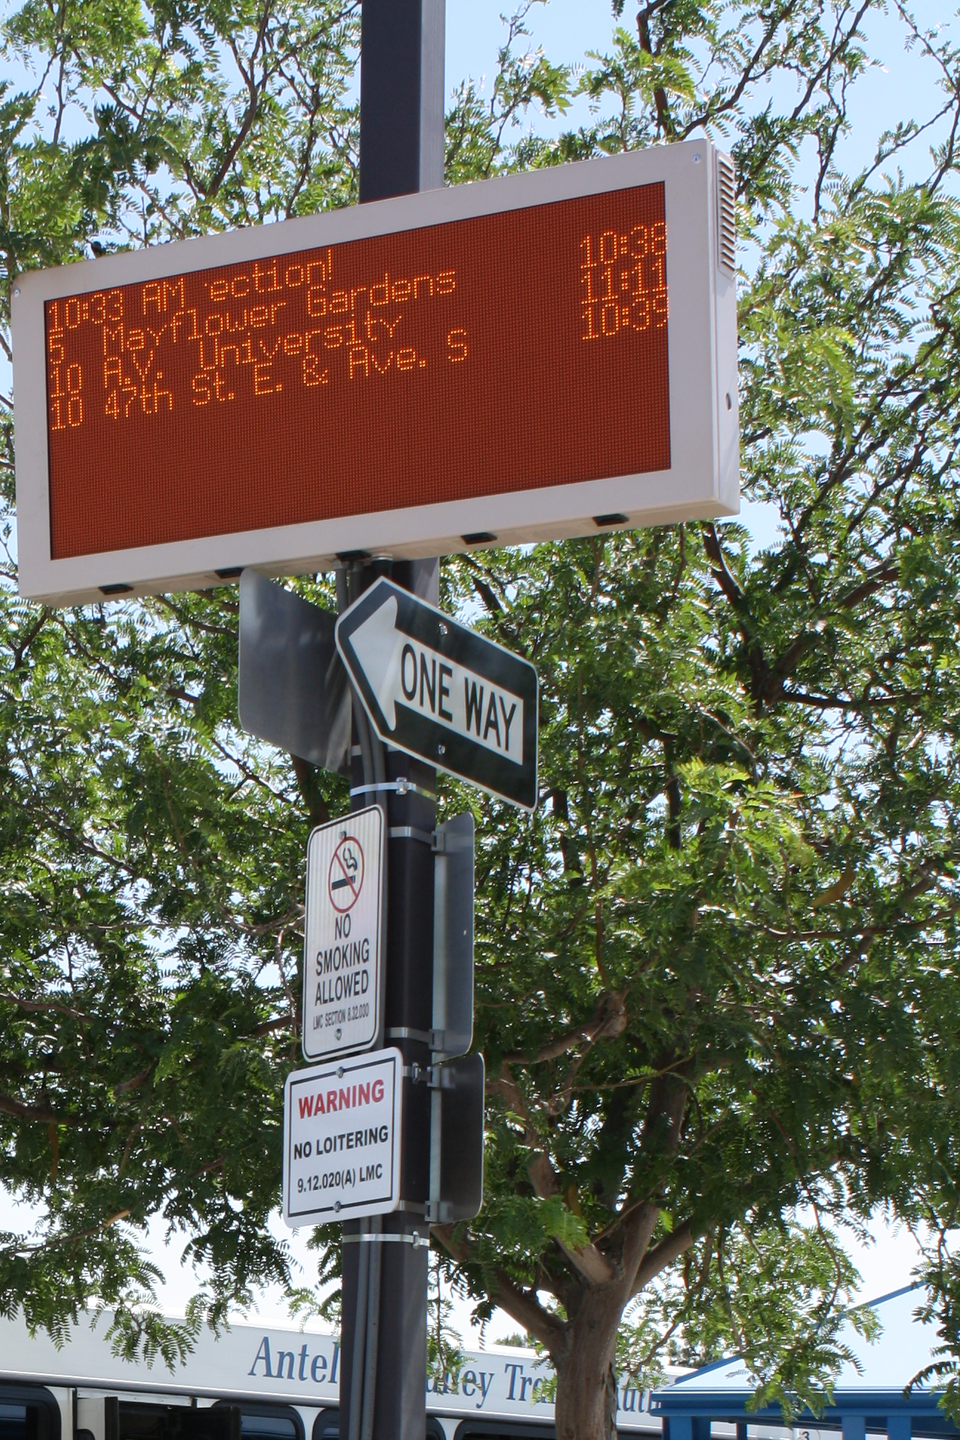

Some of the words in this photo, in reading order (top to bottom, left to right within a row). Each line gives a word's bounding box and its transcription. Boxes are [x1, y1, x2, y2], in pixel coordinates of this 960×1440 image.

[48, 333, 66, 365] 5
[102, 301, 288, 356] Mayflower
[306, 270, 457, 319] Gardens
[579, 221, 668, 269] 10:38
[48, 290, 124, 332] 10:33
[142, 277, 185, 316] AM
[50, 362, 83, 398] 10
[103, 349, 163, 389] A.V.
[198, 311, 403, 370] University
[580, 258, 669, 305] 11:11
[50, 396, 84, 431] 10
[104, 384, 174, 420] 47th
[192, 370, 236, 406] St.
[253, 361, 284, 396] E.
[301, 353, 330, 387] &
[348, 345, 427, 379] Ave.
[447, 328, 469, 363] S
[581, 293, 671, 341] 10:39
[400, 642, 453, 724] ONE
[464, 676, 518, 752] WAY
[334, 912, 352, 942] NO
[315, 938, 370, 976] SMOKING
[314, 970, 369, 1007] ALLOWED
[312, 1014, 323, 1030] LMC
[325, 1007, 346, 1028] SECTION
[347, 1003, 370, 1021] 8.32.030
[298, 1079, 385, 1120] WARNING
[293, 1141, 313, 1160] NO
[316, 1125, 389, 1156] LOITERING
[297, 1169, 356, 1194] 9.12.020(A)
[359, 1163, 383, 1183] LMC
[247, 1336, 339, 1384] Antel
